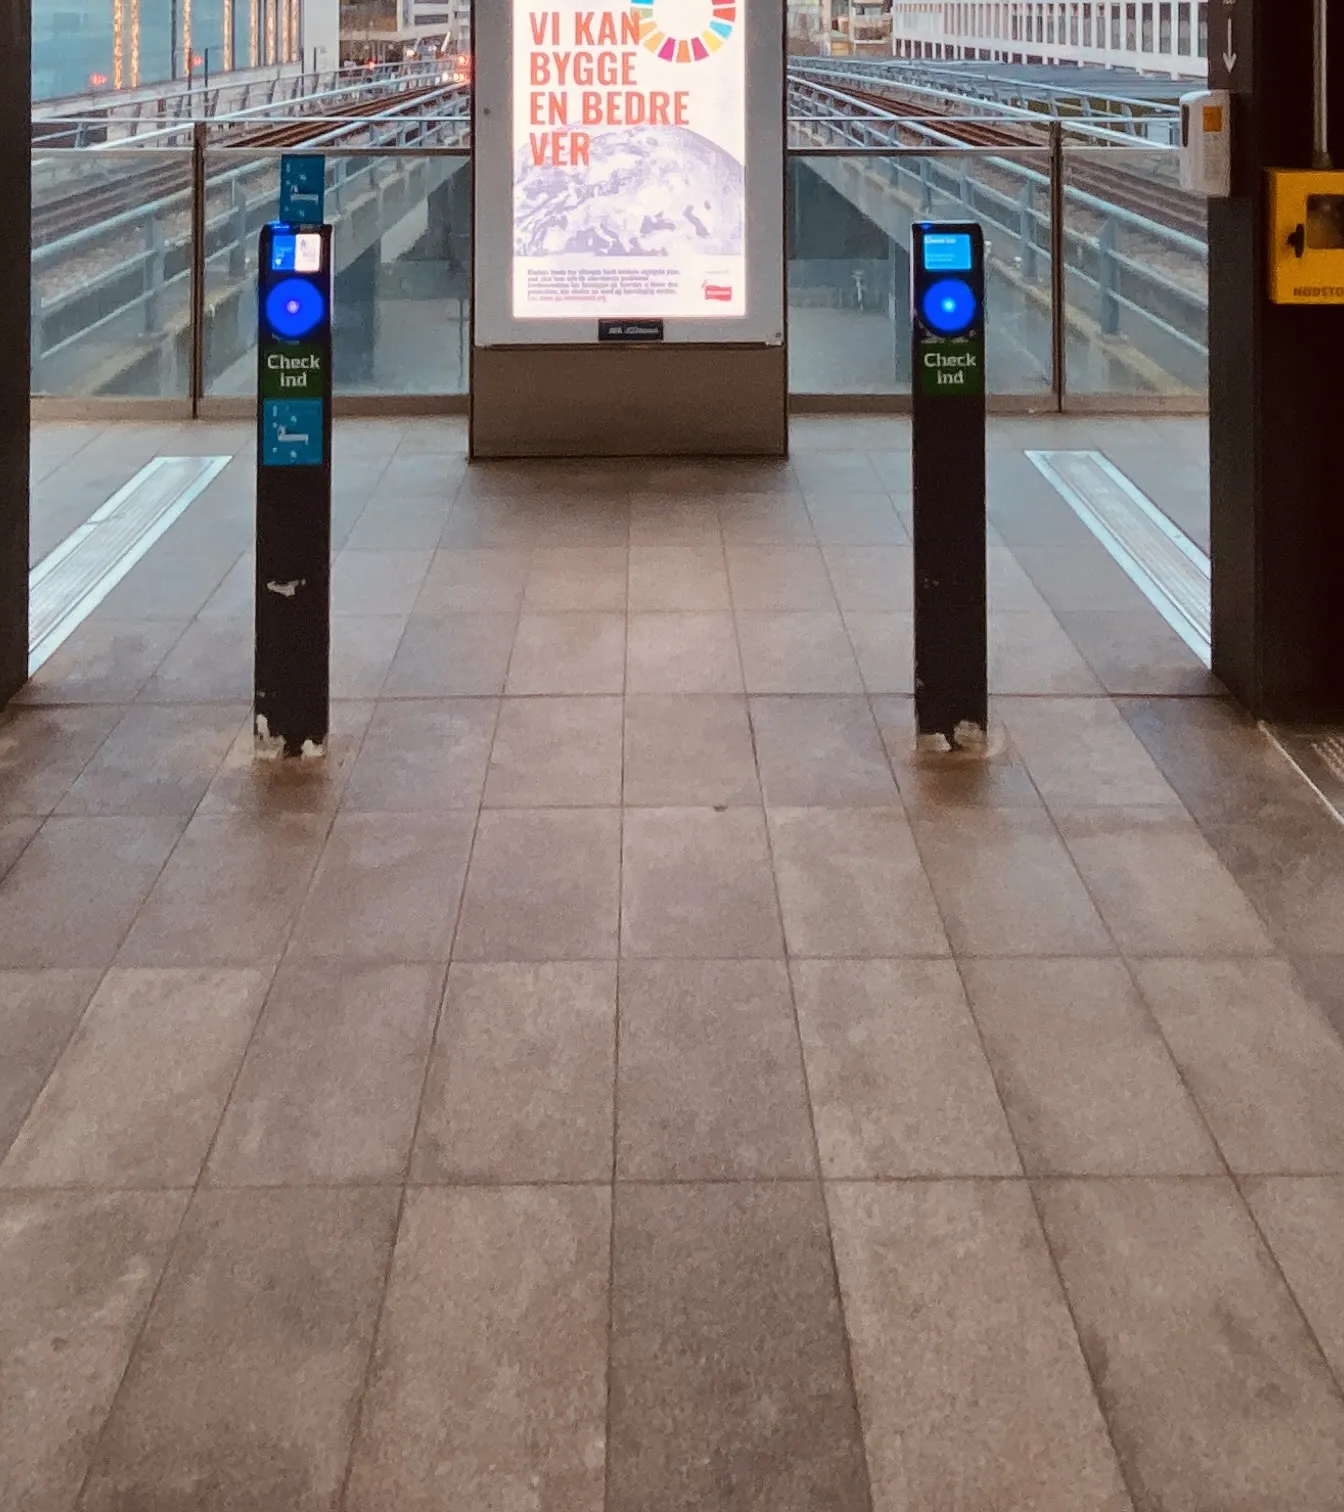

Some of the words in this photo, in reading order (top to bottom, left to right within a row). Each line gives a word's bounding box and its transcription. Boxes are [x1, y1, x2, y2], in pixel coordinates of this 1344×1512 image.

[529, 12, 559, 45] VI
[575, 12, 640, 45] KAN
[530, 52, 637, 86] BYGGE
[530, 92, 567, 125] EN
[583, 91, 690, 125] BEDRE
[529, 132, 590, 166] VER
[267, 354, 320, 369] Check
[924, 352, 977, 367] Check
